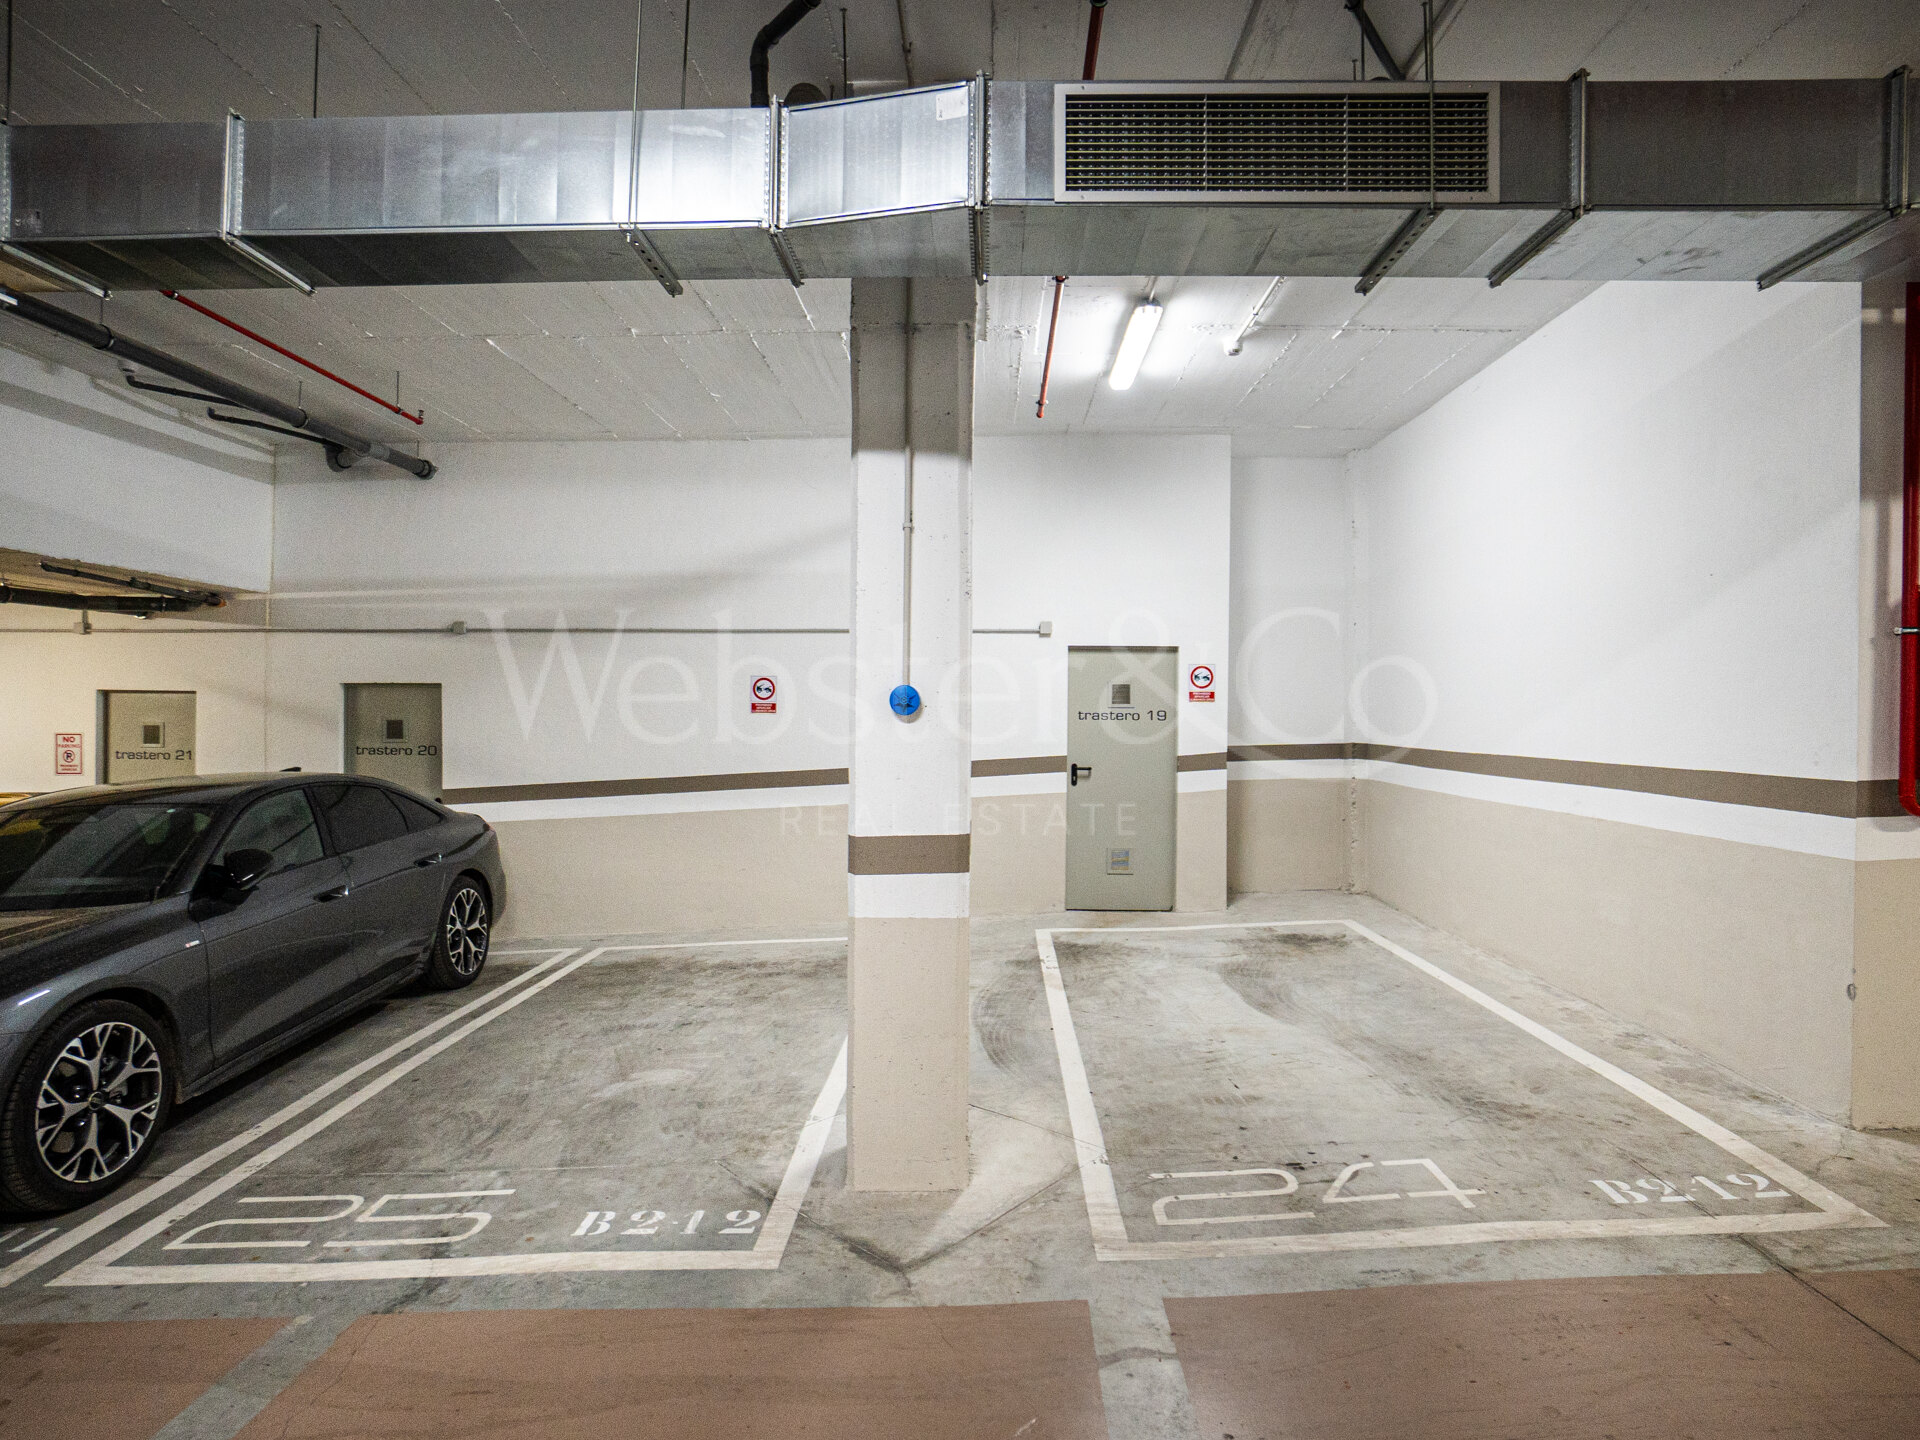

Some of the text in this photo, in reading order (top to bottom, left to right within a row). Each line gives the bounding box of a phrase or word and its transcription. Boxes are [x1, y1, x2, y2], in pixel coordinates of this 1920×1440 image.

[1078, 710, 1167, 721] trastero 19
[115, 750, 193, 760] trastero 21
[356, 745, 438, 756] trastero 20
[1150, 1157, 1484, 1227] 24
[162, 1188, 516, 1250] 25
